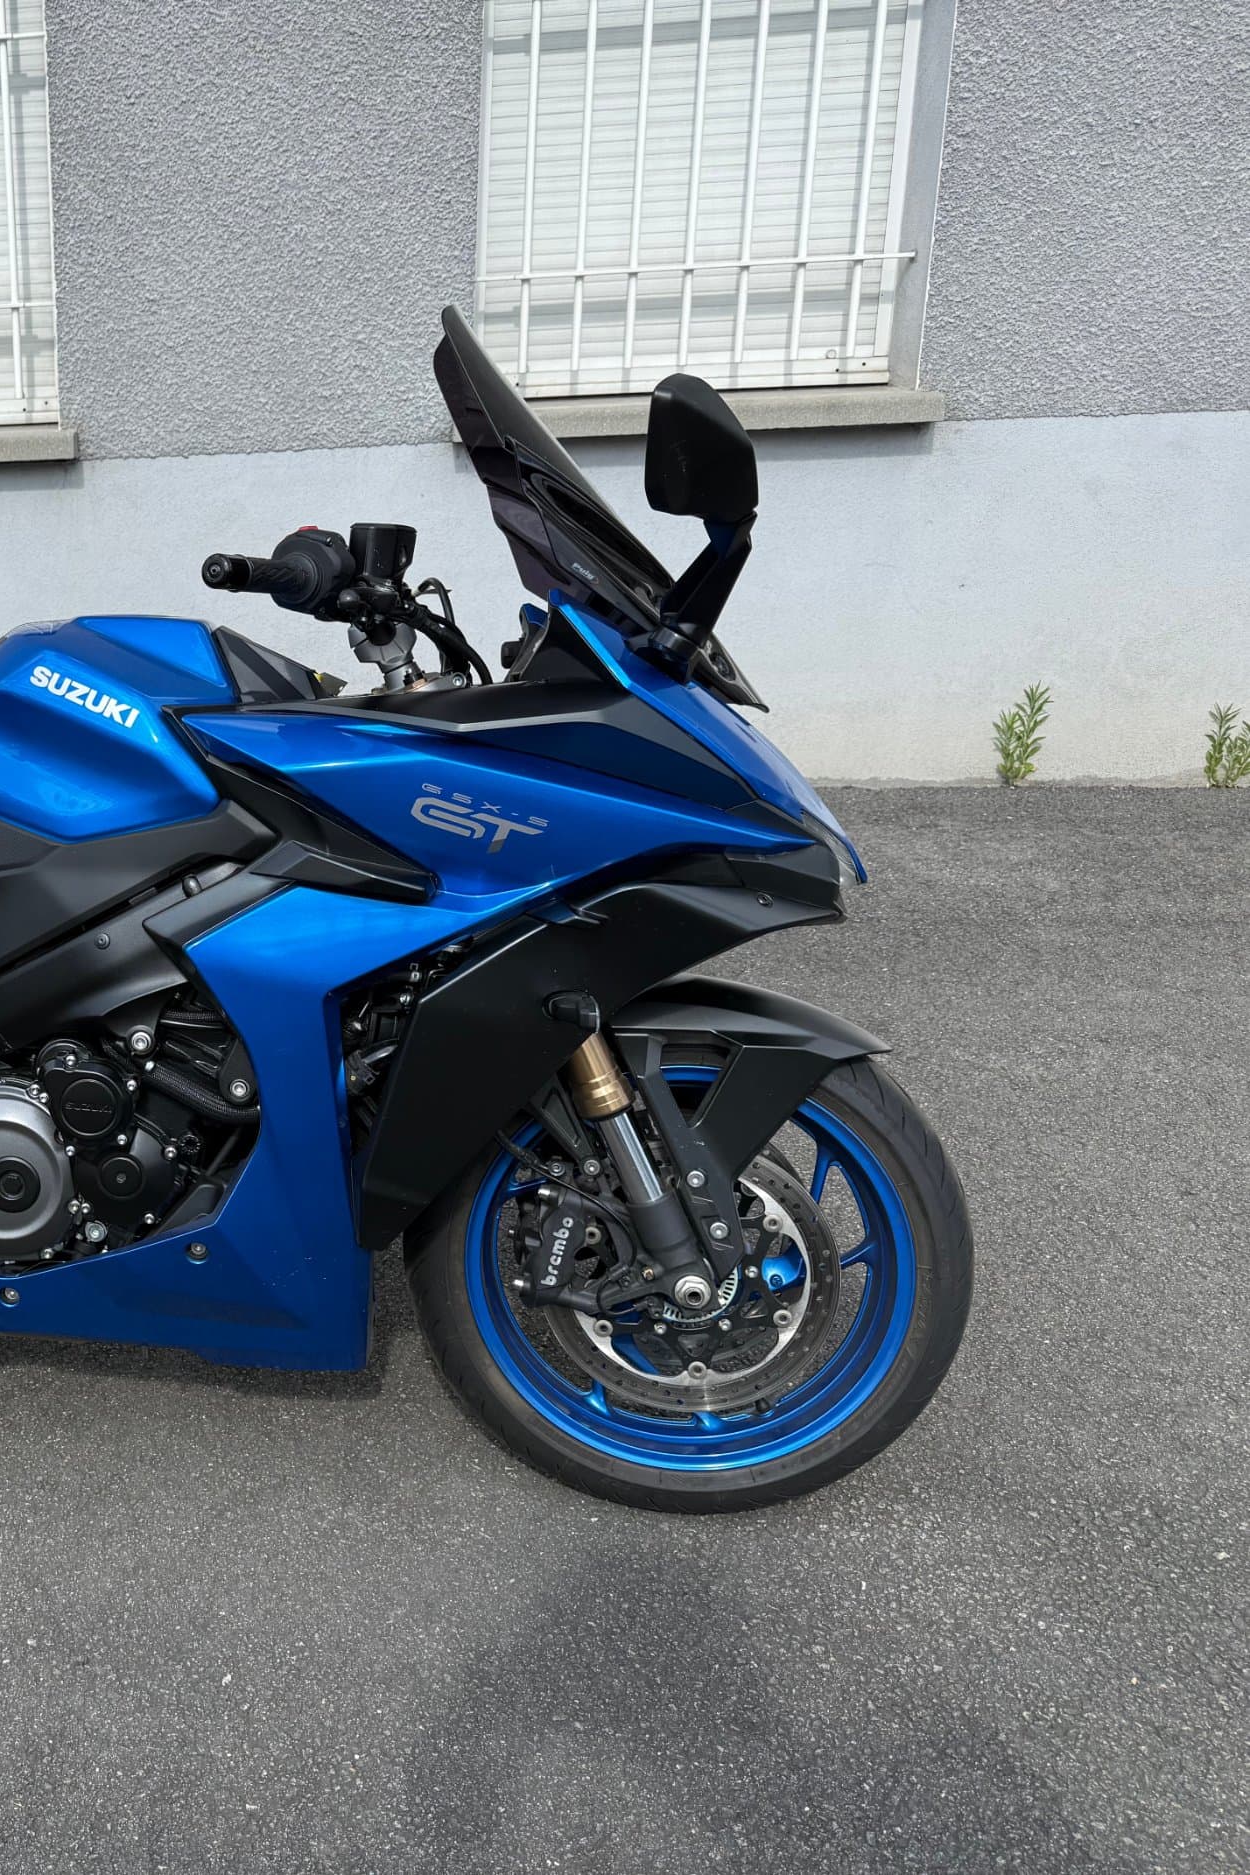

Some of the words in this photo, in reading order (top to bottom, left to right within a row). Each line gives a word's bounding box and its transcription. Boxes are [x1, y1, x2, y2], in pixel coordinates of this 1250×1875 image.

[29, 665, 141, 729] SUZUKI
[410, 796, 544, 855] GT
[540, 1216, 574, 1286] brembo
